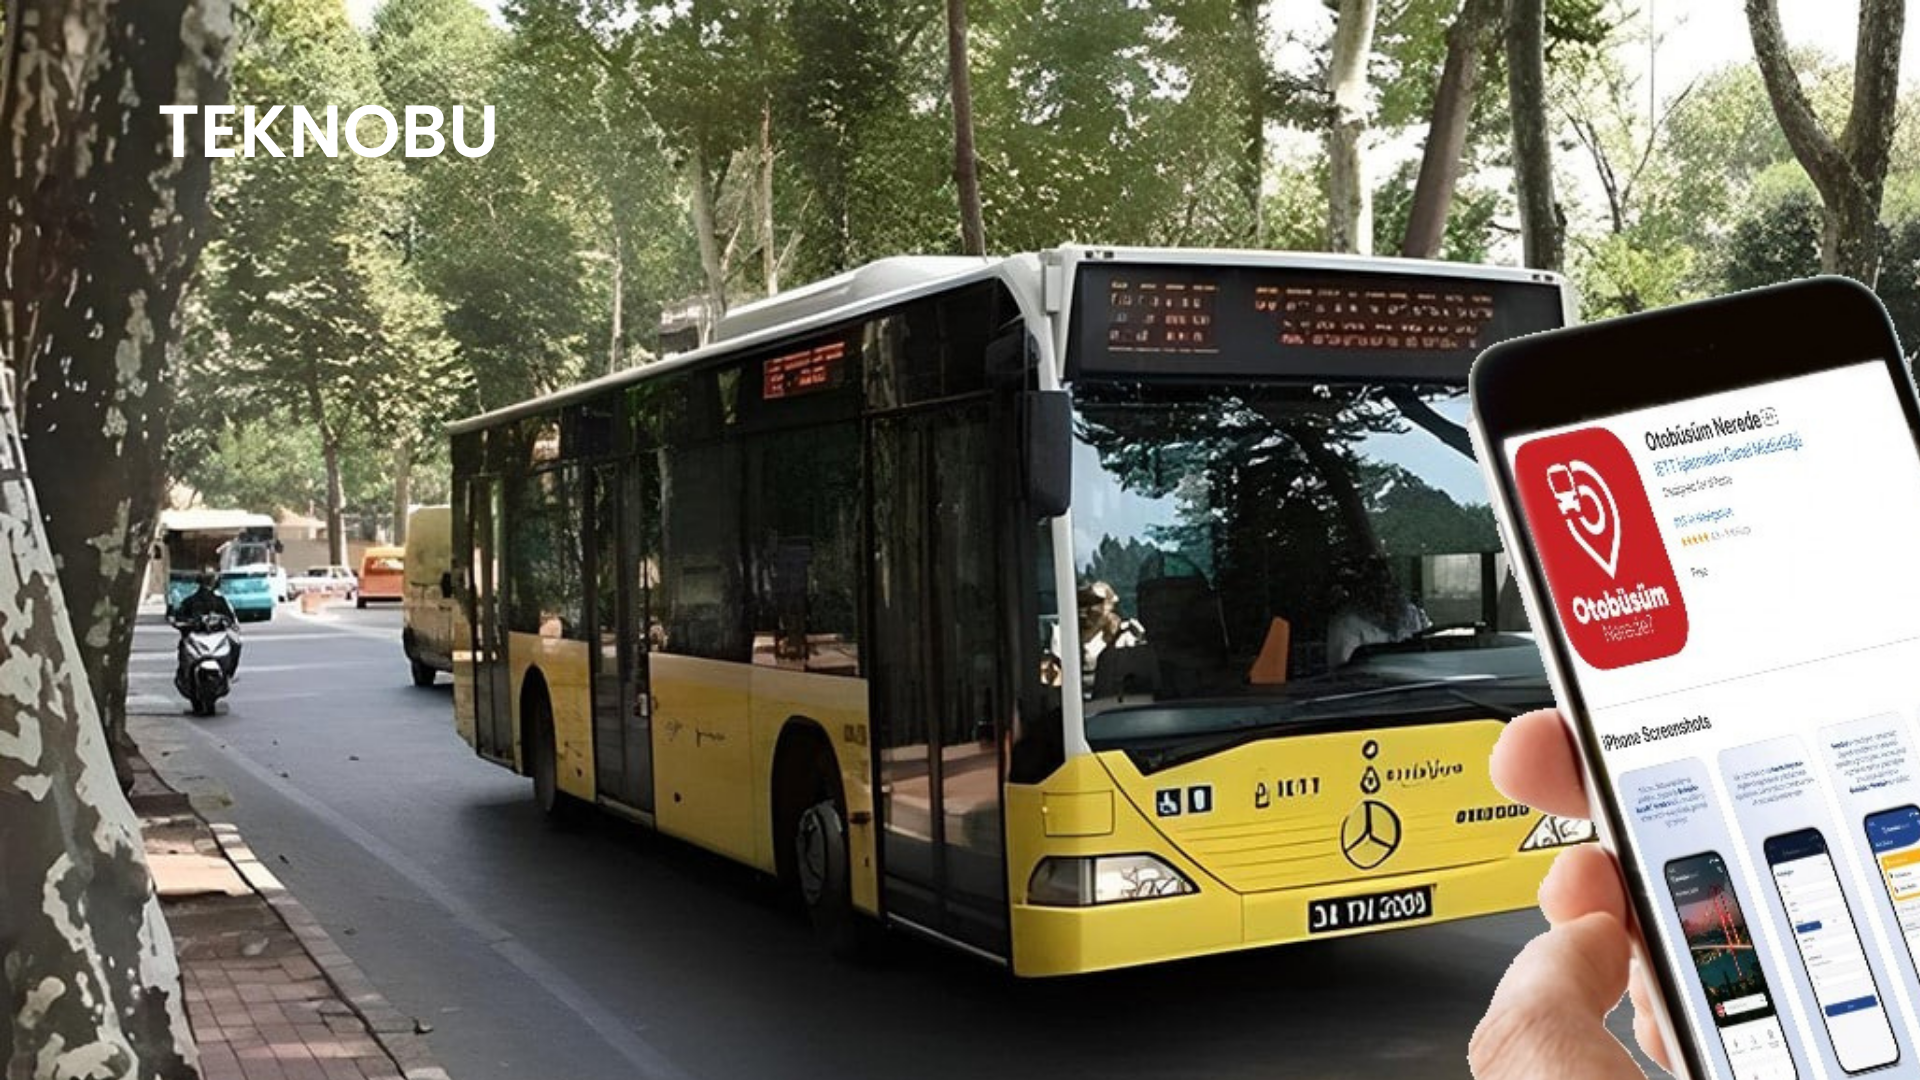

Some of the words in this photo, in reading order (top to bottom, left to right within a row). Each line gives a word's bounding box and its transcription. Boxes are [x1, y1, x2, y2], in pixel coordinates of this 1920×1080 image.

[1711, 411, 1763, 437] Nerede
[1572, 583, 1670, 625] Otobüsüm
[1600, 731, 1642, 752] iPhone
[1641, 715, 1712, 743] Screenshots
